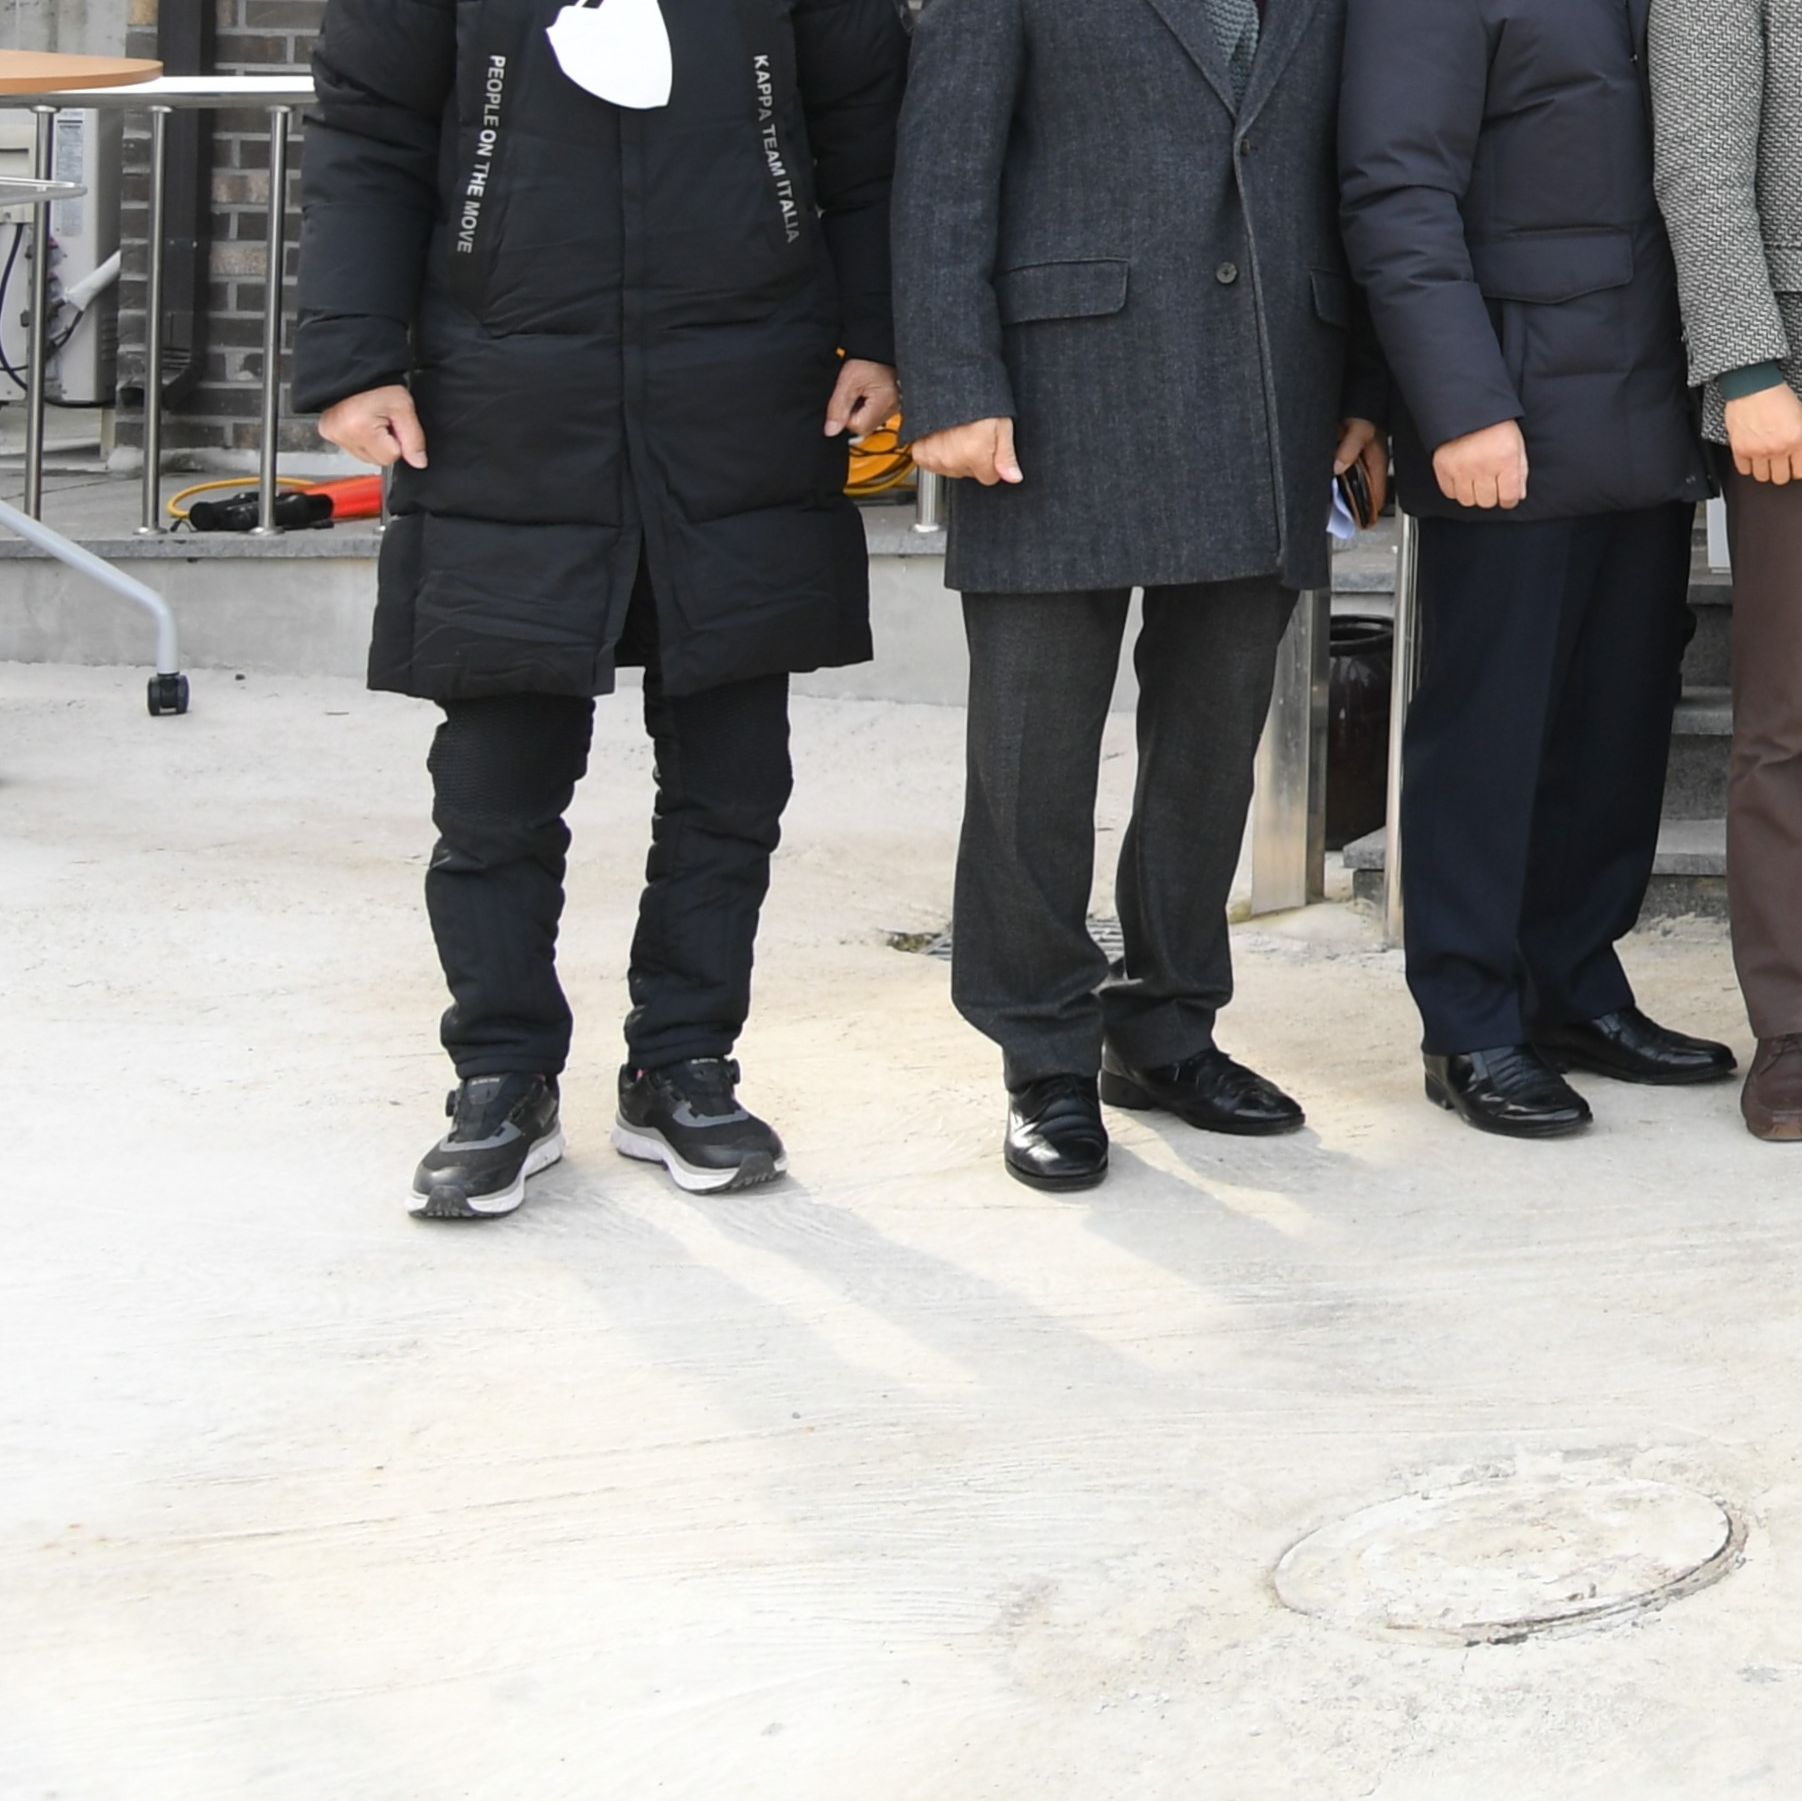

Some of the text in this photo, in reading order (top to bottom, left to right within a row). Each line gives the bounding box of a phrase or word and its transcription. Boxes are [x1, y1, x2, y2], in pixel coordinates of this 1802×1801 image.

[457, 55, 506, 254] PEOPLE ON THE MOVE
[753, 54, 800, 244] KAPPA TEAM ITALIA
